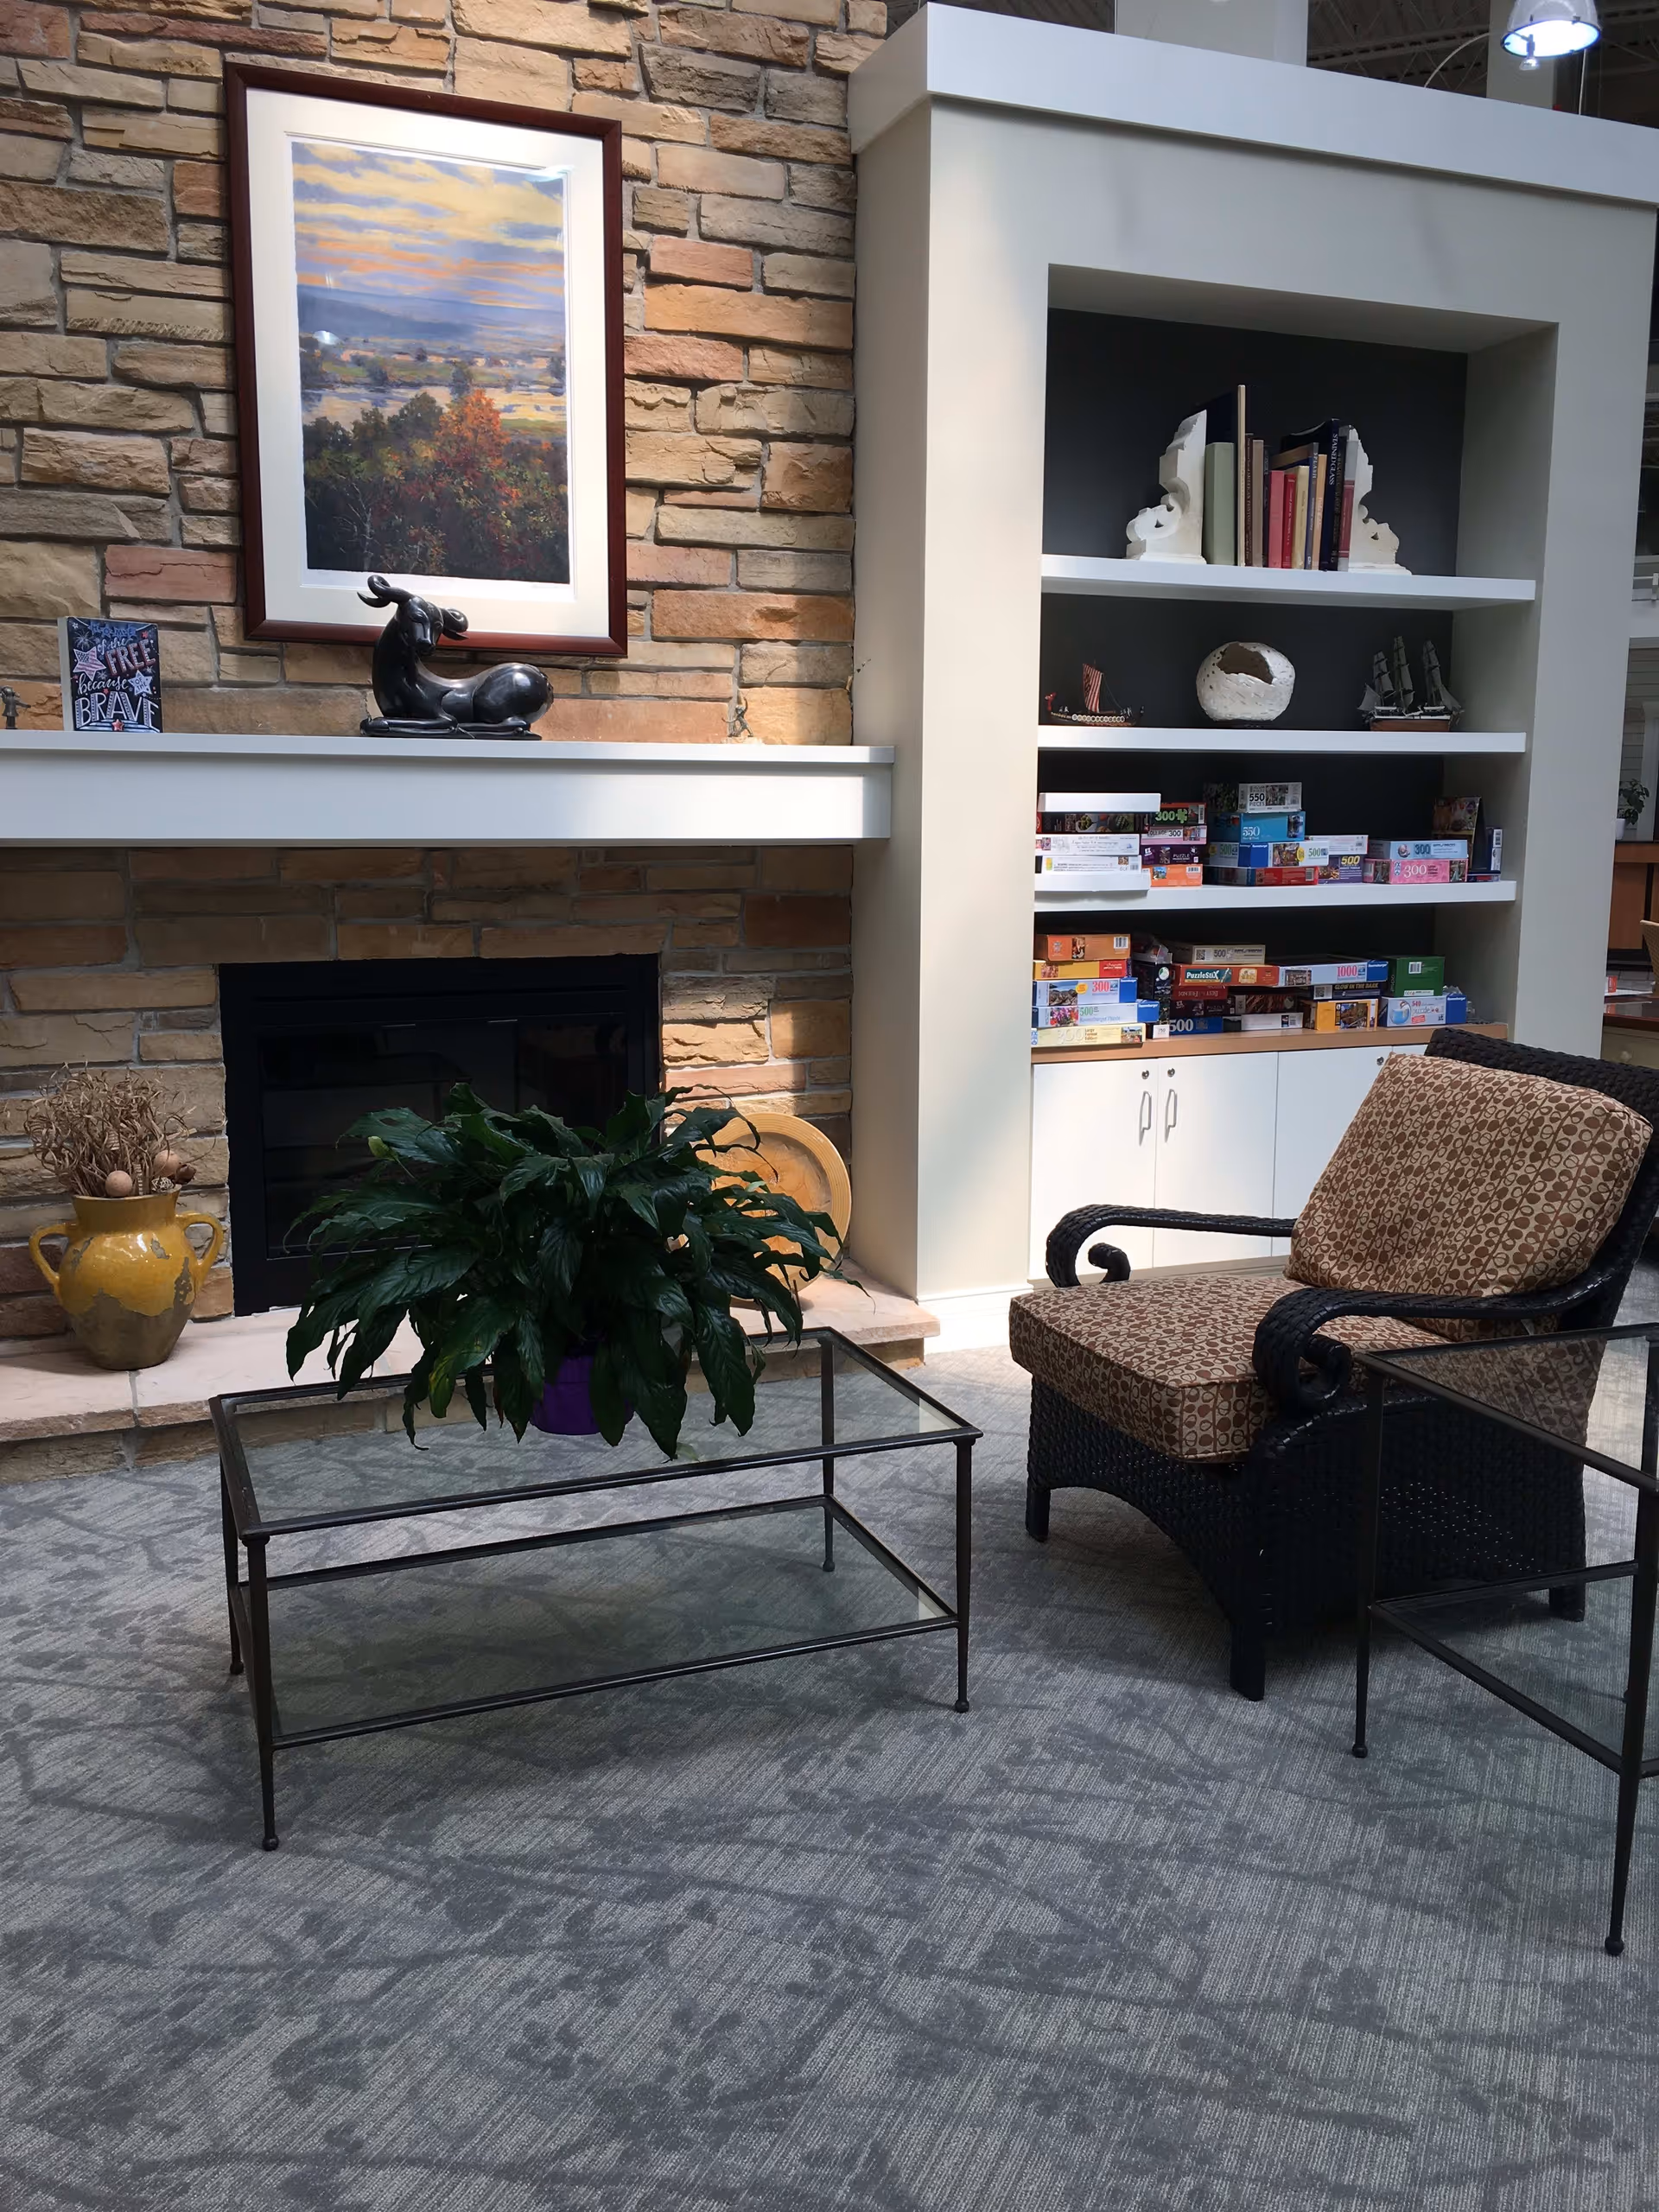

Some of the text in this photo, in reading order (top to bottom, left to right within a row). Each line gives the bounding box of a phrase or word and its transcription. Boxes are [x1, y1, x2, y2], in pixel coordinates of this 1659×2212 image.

[97, 637, 133, 654] of the
[105, 639, 156, 676] FREE
[78, 672, 130, 695] because
[74, 690, 161, 733] BRAVE
[1249, 792, 1265, 802] 550
[1154, 810, 1175, 822] 300
[1242, 826, 1261, 837] 550
[1308, 848, 1321, 857] 500
[1414, 843, 1431, 855] 300
[1341, 855, 1361, 865] 500
[1403, 864, 1427, 879] 300
[1213, 949, 1226, 957] 500
[1337, 965, 1357, 977] 1000
[1091, 981, 1109, 993] 300
[1079, 1007, 1094, 1016] 500
